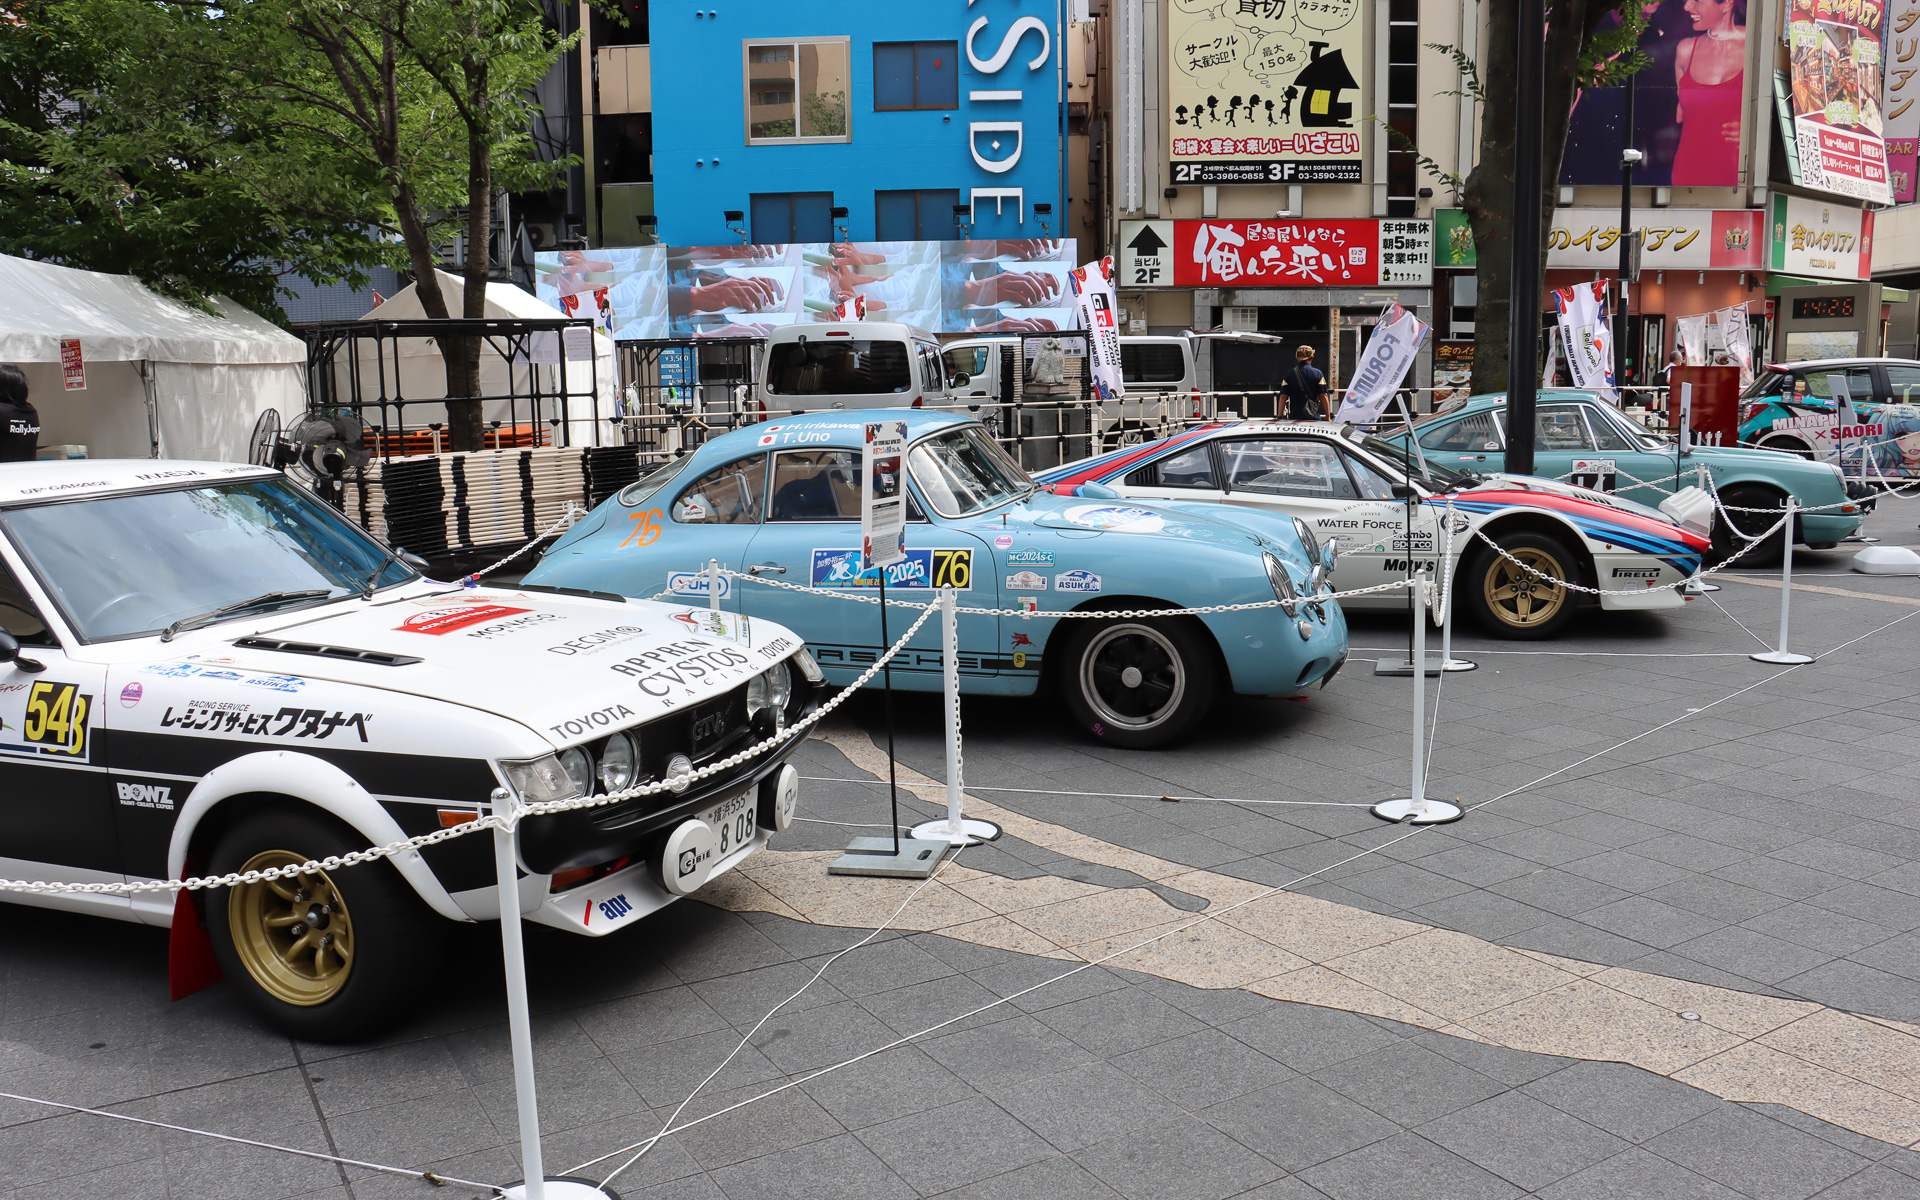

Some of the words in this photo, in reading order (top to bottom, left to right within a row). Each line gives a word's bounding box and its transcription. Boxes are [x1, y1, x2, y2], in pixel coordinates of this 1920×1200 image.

[1185, 35, 1238, 55] サークル
[1262, 44, 1284, 58] 最大
[1189, 49, 1237, 71] 大歓迎!
[1259, 53, 1296, 70] 150名
[1889, 0, 1920, 121] タリアン
[965, 0, 1050, 225] SIDE
[1885, 141, 1913, 155] BAR
[1175, 165, 1202, 181] 2F
[1268, 164, 1296, 181] 3F
[1247, 223, 1346, 247] 居酒屋いくなら
[1383, 222, 1429, 234] 年中無休
[1383, 236, 1429, 250] 朝5時まで
[1791, 221, 1856, 254] 金のイタリアン
[1134, 258, 1161, 267] 当ビル
[1809, 258, 1827, 268] PIZZERIA
[1828, 261, 1836, 269] BAR
[1135, 268, 1160, 284] 2F
[1091, 293, 1107, 328] GR
[1802, 299, 1852, 317] 14:26
[1105, 330, 1116, 366] GAZOO
[1567, 344, 1575, 359] RALLY
[782, 432, 831, 444] T.Uno
[1830, 423, 1883, 440] SAORI
[1343, 502, 1370, 512] FRANCK
[1374, 502, 1400, 513] MULLER
[619, 508, 663, 548] 76
[1317, 519, 1359, 529] WATER
[1363, 519, 1402, 529] FORCE
[1021, 551, 1041, 561] 2024
[888, 559, 925, 583] 2025
[934, 551, 969, 587] 76
[1612, 568, 1661, 578] PIRELLI
[678, 579, 721, 590] UH
[467, 613, 555, 638] MONACO
[757, 637, 793, 659] TOYOTA
[610, 638, 713, 677] APPREN
[638, 647, 748, 697] CVSTOS
[128, 683, 139, 691] OK
[245, 679, 289, 688] ASUKA
[662, 664, 759, 707] RACING
[25, 682, 75, 743] 54
[188, 700, 217, 709] RACING
[217, 702, 250, 712] SERVICE
[549, 703, 636, 740] TOYOTA
[116, 782, 174, 804] BOWZ
[156, 802, 174, 810] EXPERT
[685, 850, 711, 867] CIBIE
[599, 893, 633, 921] apr
